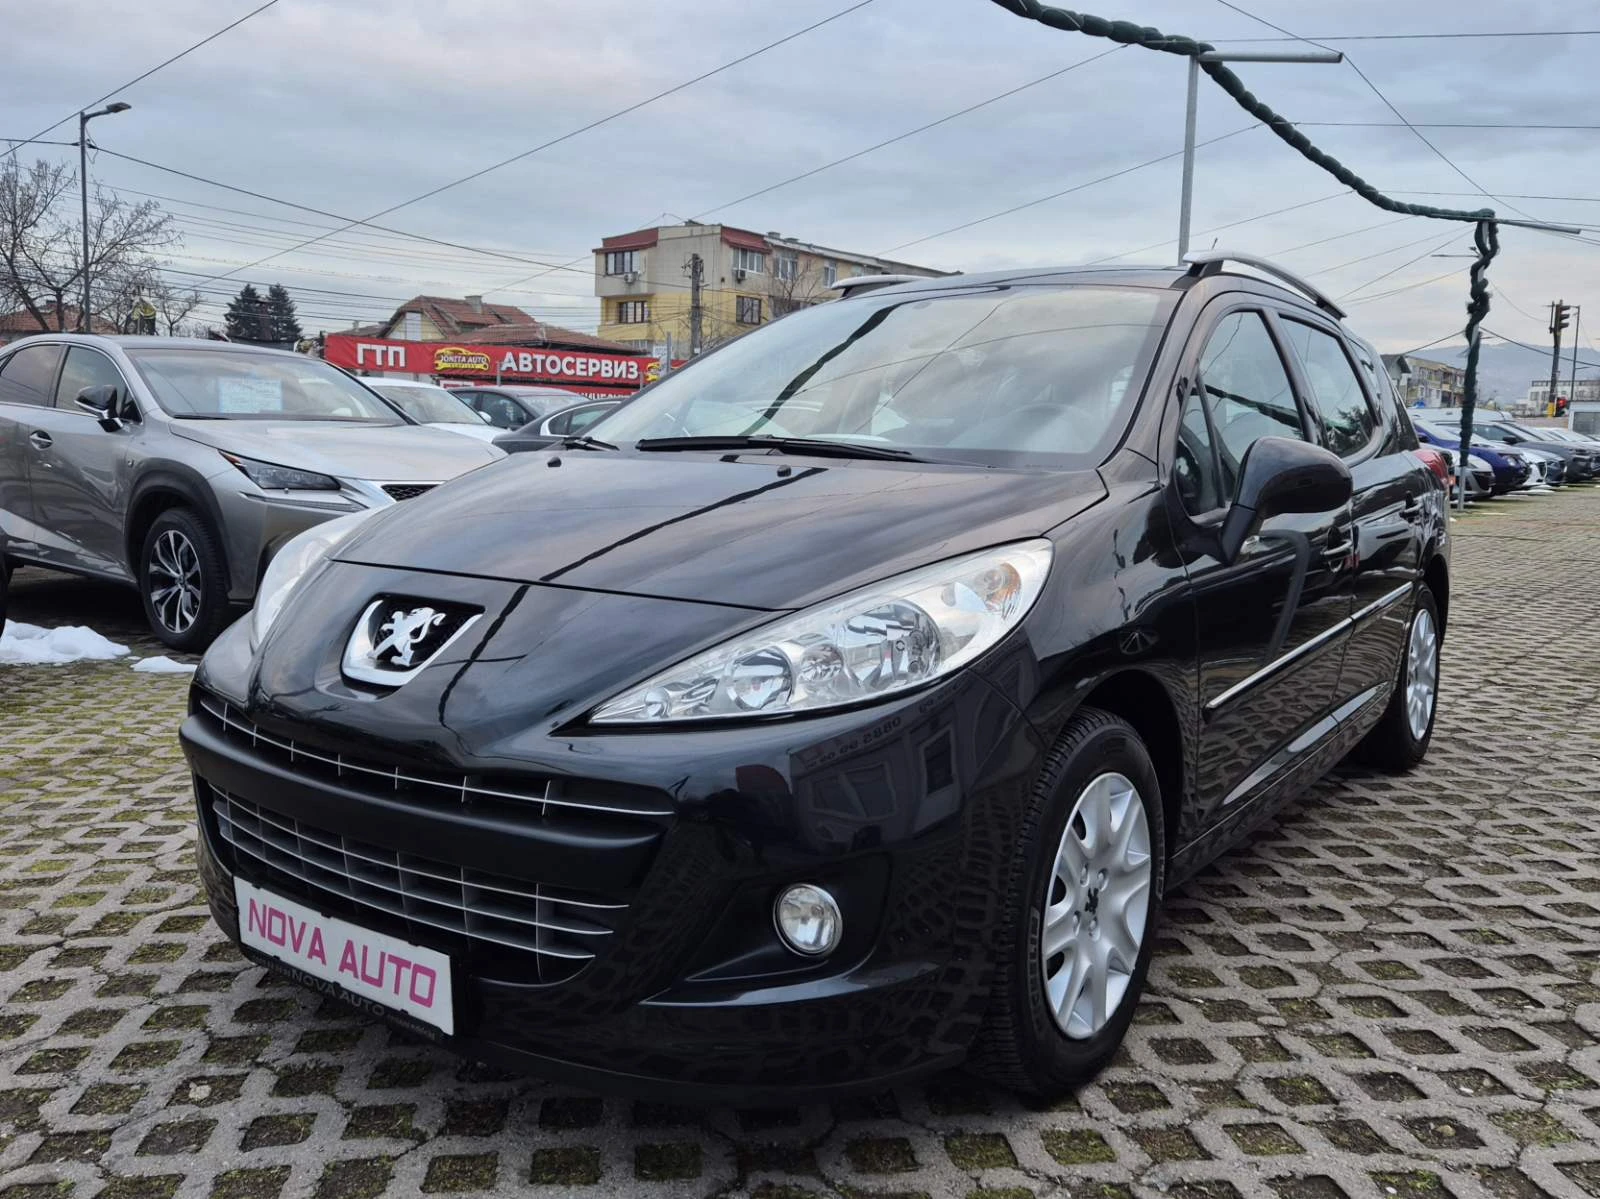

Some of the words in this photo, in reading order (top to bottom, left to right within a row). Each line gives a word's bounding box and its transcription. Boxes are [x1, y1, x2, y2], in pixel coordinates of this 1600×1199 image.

[356, 343, 406, 368] ГТП
[467, 355, 487, 363] AUTO
[500, 351, 638, 379] АВТОСЕРВИЗ
[248, 898, 327, 966] NOVA
[338, 939, 436, 1008] AUTO
[292, 970, 335, 995] NOVA
[339, 992, 385, 1017] AUTO
